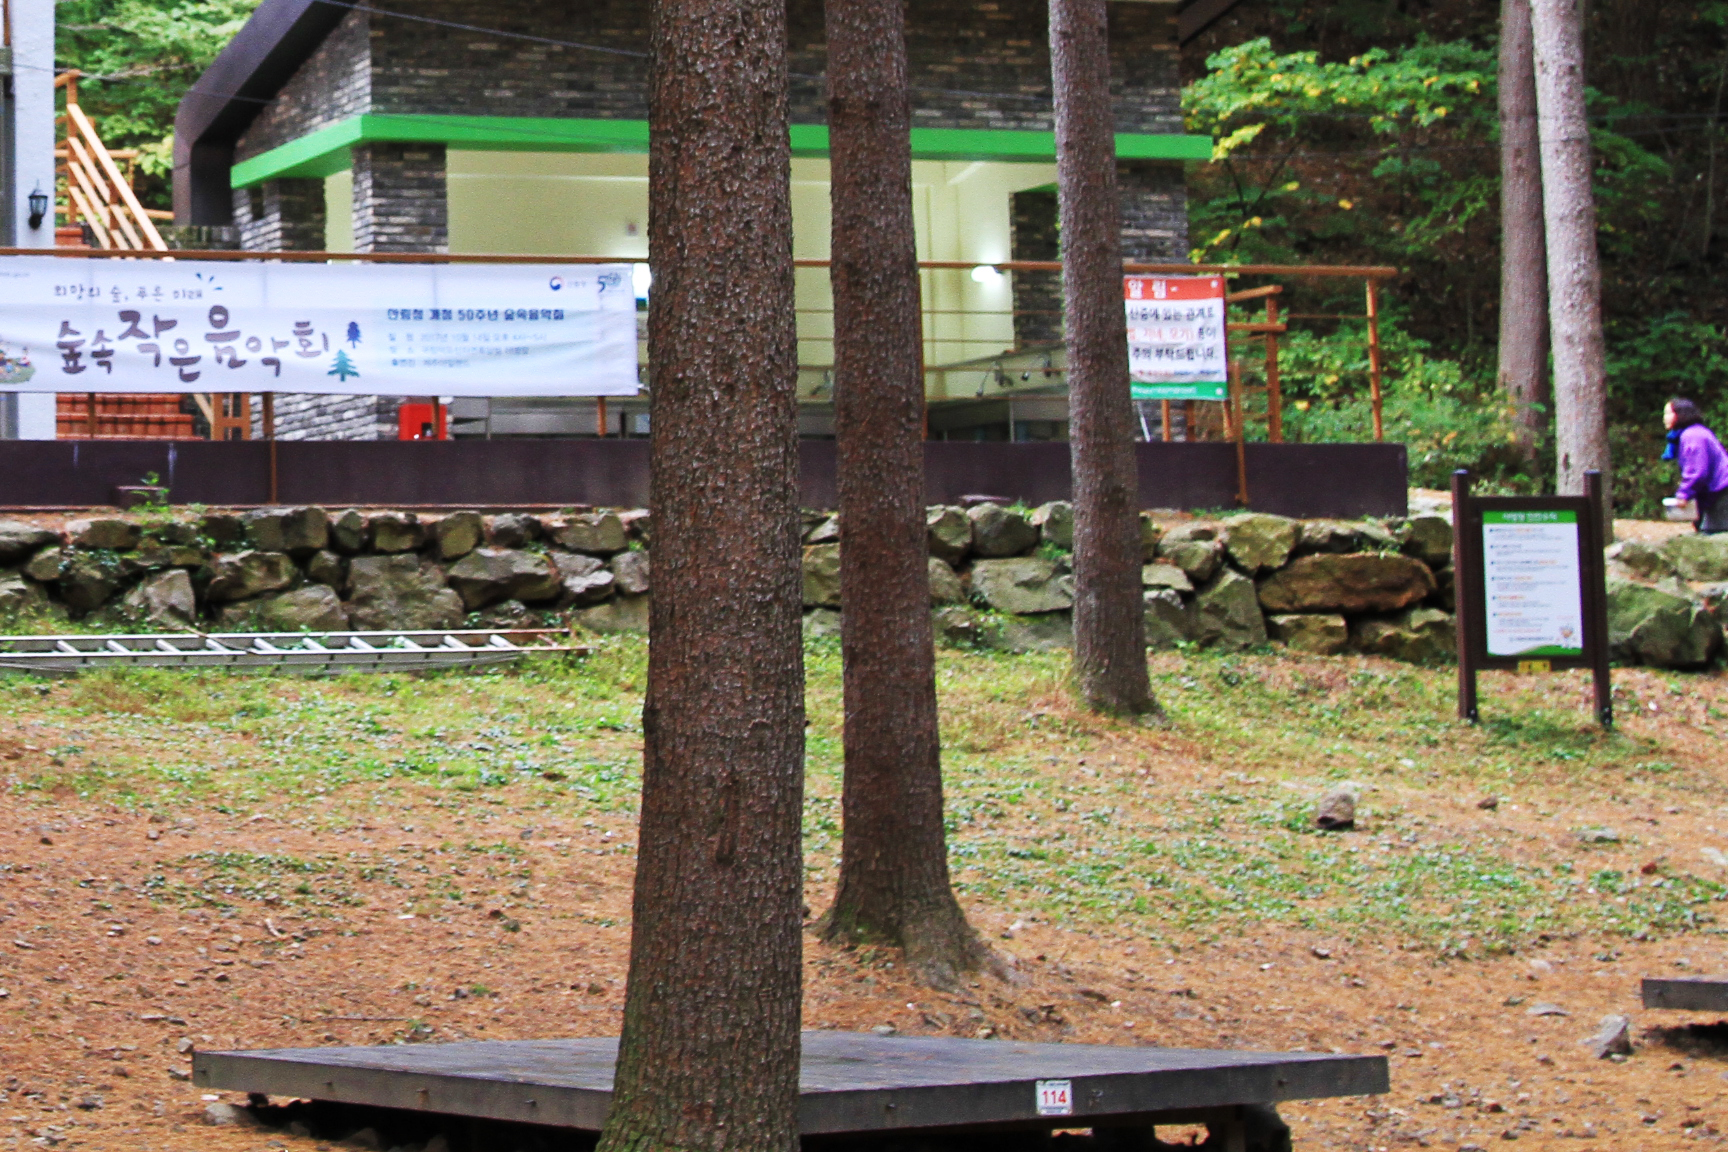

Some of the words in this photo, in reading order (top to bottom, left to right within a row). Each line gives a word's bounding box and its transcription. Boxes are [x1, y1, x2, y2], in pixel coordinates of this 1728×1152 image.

[54, 284, 100, 300] 희망의
[136, 285, 164, 302] 푸른
[173, 288, 203, 300] 미래
[458, 308, 499, 321] 50주년
[56, 320, 114, 375] 숲속
[118, 309, 202, 382] 작은
[204, 305, 329, 377] 음악회
[1042, 1090, 1067, 1105] 114
